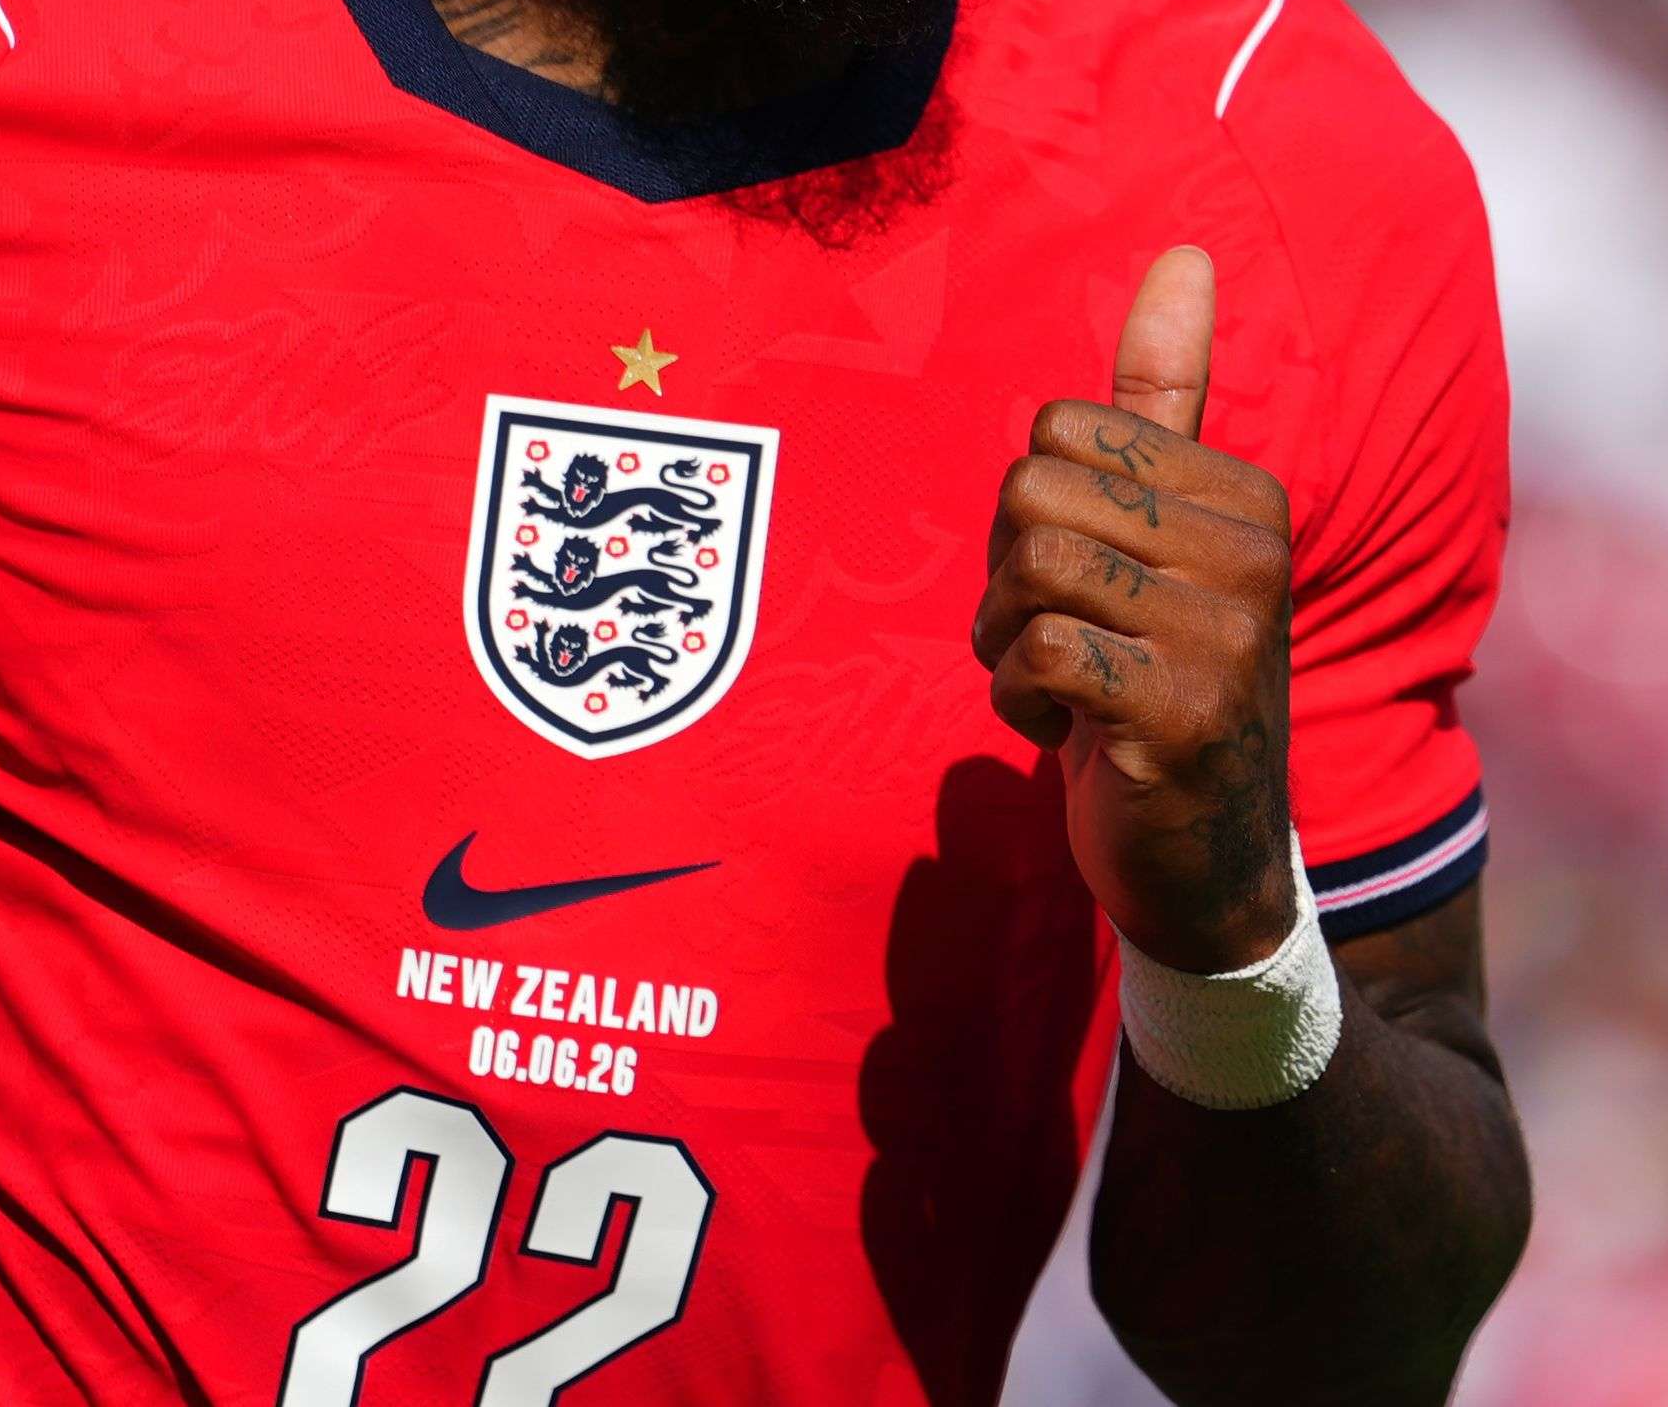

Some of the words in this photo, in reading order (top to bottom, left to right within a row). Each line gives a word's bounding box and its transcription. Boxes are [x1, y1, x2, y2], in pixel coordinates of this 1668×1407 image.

[396, 948, 503, 1010] NEW
[510, 966, 718, 1038] ZEALAND
[469, 1025, 637, 1096] 06.06.26
[275, 1085, 717, 1407] 22
